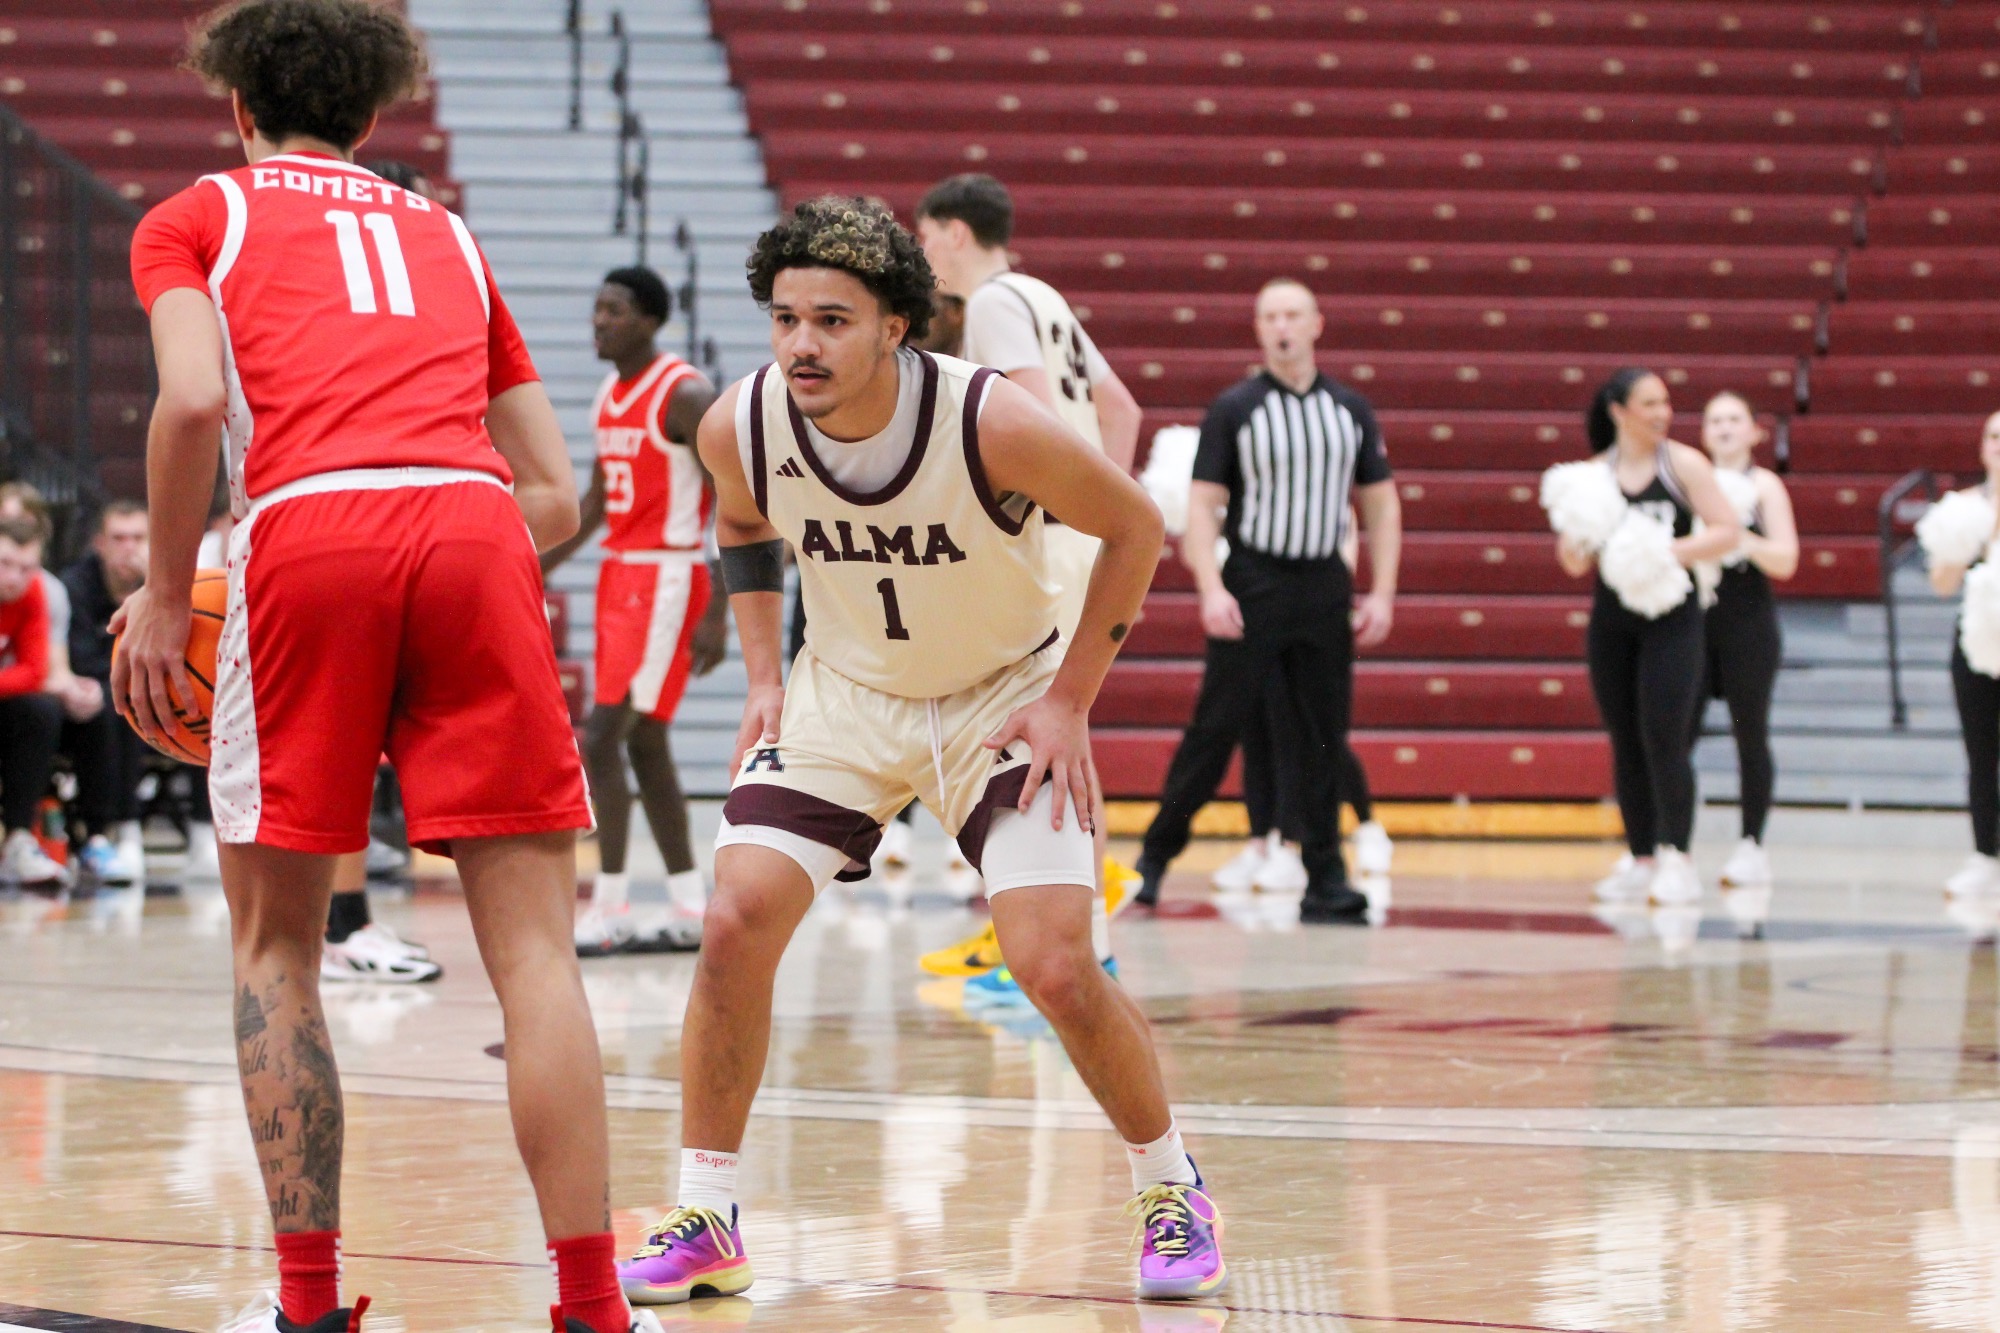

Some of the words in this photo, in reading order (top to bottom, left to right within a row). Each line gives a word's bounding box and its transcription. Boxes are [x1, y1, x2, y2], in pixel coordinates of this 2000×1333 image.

[251, 168, 431, 212] COMETS
[324, 209, 416, 317] 11
[802, 519, 967, 565] ALMA
[876, 577, 911, 641] 1
